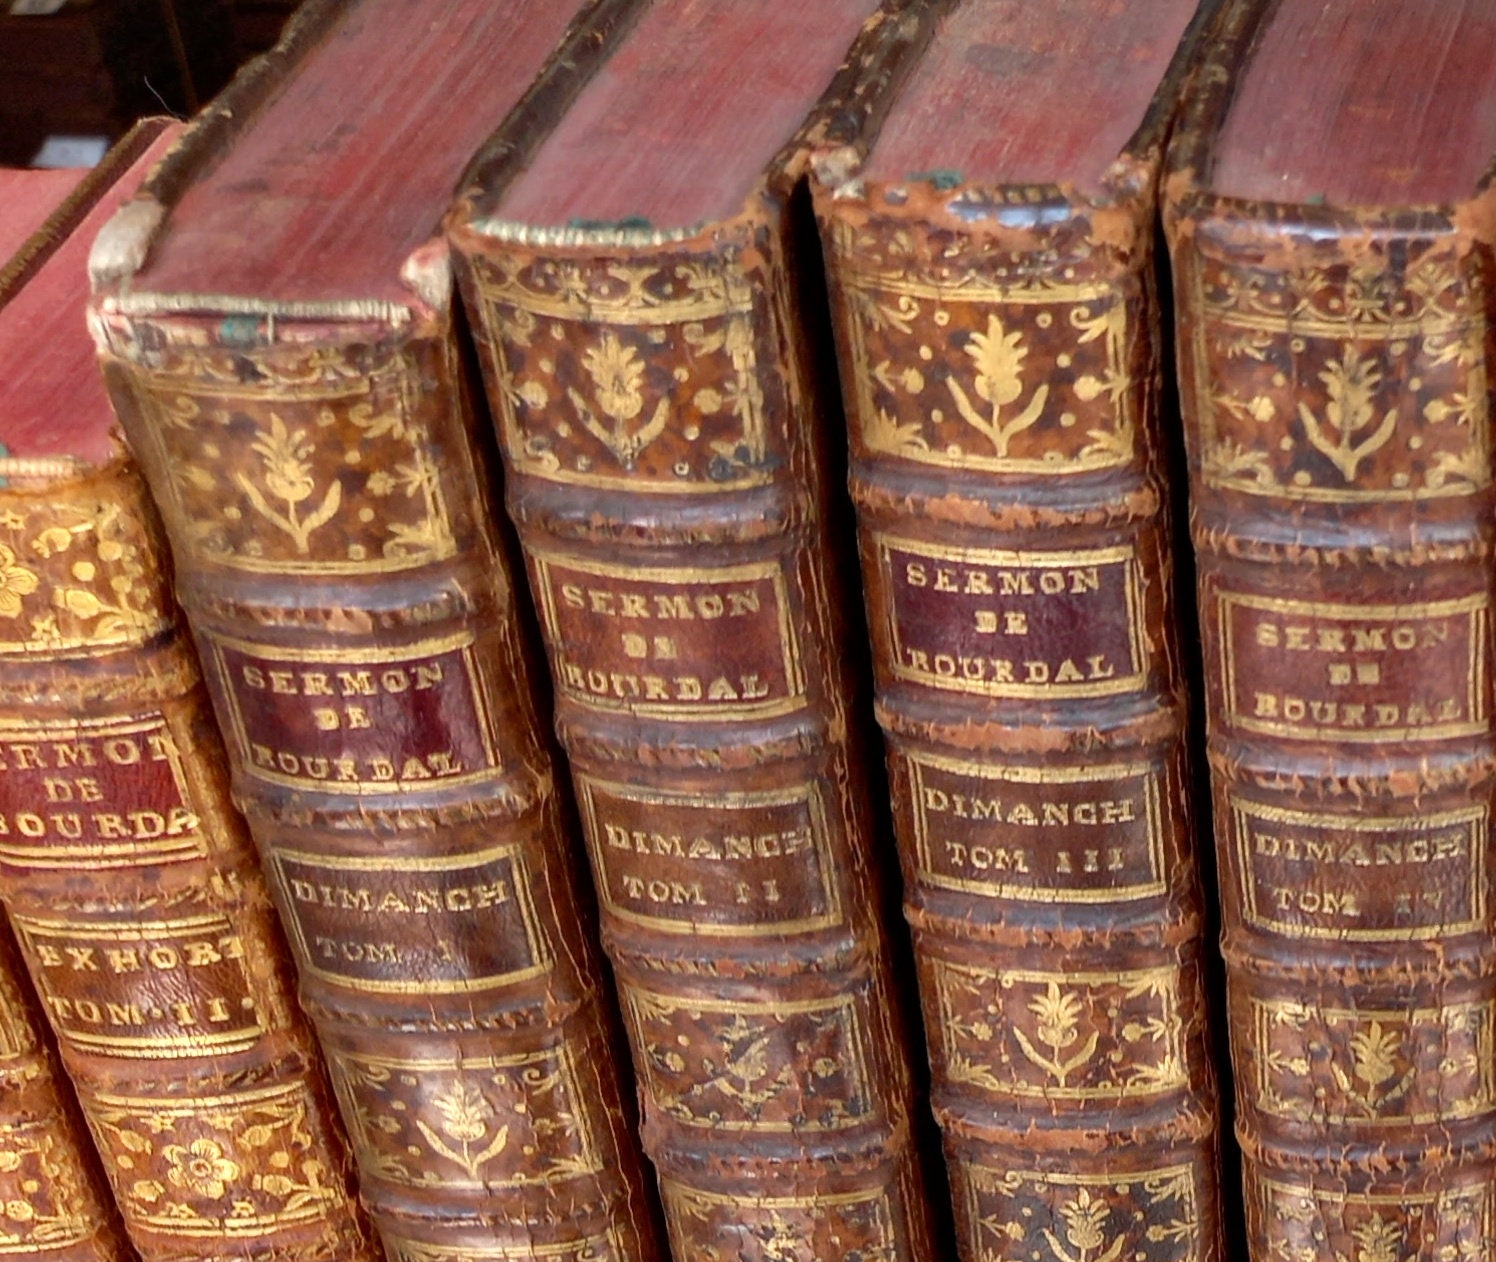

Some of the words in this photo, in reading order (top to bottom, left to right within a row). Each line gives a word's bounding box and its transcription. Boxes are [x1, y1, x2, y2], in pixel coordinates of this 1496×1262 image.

[906, 563, 1101, 595] SERMON
[562, 585, 760, 620] SERMON
[1256, 622, 1449, 652] SERMON
[242, 663, 445, 696] SERMON
[44, 777, 103, 802] DE
[924, 787, 1136, 826] DIMANCH
[604, 823, 812, 860] DIMANCH
[945, 840, 1029, 873] TOM
[1255, 832, 1467, 866] DIMANCH
[292, 880, 507, 913] DIMANCH
[622, 874, 707, 905] TOM
[1272, 887, 1361, 917] TOM
